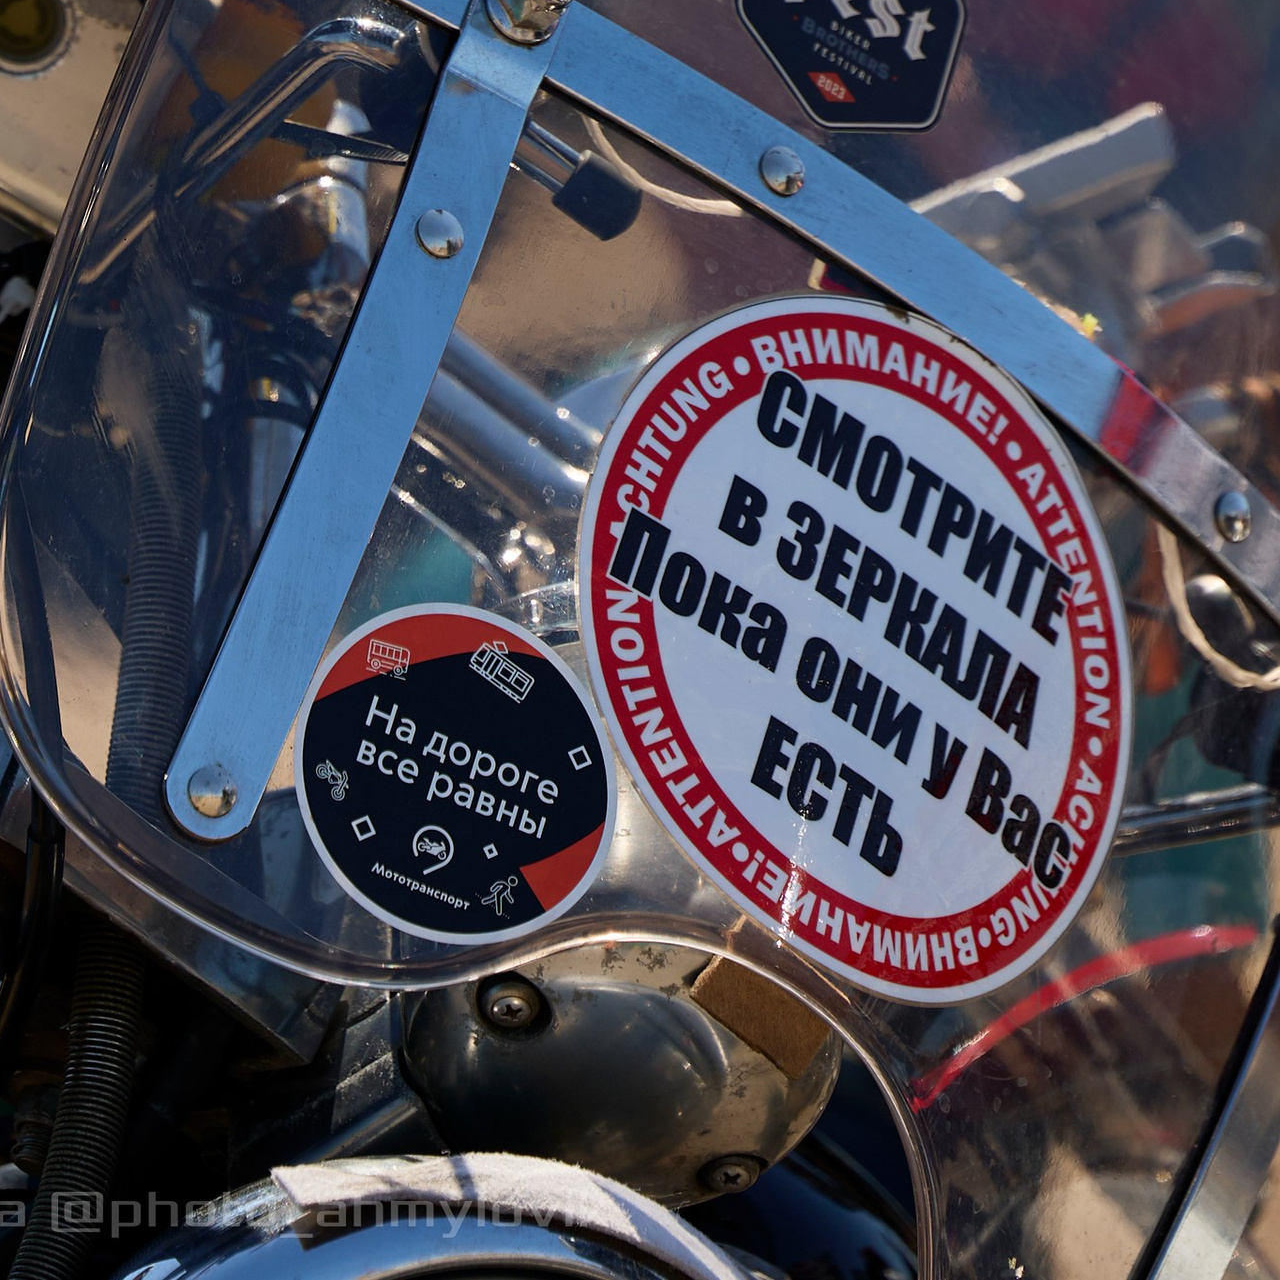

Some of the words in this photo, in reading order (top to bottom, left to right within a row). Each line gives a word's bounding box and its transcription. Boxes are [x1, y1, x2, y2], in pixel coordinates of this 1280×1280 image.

[801, 16, 891, 81] BROTHERS
[813, 42, 874, 86] FESTIVAL
[818, 73, 847, 101] 2023
[830, 19, 871, 52] BIKER
[750, 328, 1010, 442] ВНИМАНИЕ!
[609, 361, 734, 539] CHTUNG
[757, 370, 1074, 646] СМОТРИТЕ
[776, 500, 1041, 750] ЗЕРКАЛА
[1016, 461, 1112, 729] ATTENTION
[365, 695, 417, 745] На
[422, 731, 559, 805] дороге
[605, 589, 742, 848] ATTENTION
[609, 507, 789, 674] Пока
[796, 636, 923, 766] они
[965, 746, 1071, 890] Вас
[356, 739, 419, 784] все
[426, 770, 547, 840] равны
[750, 715, 904, 878] ЕСТЬ
[371, 861, 470, 911] Мототранспорт
[742, 848, 980, 973] ВНИМАНИЕ!
